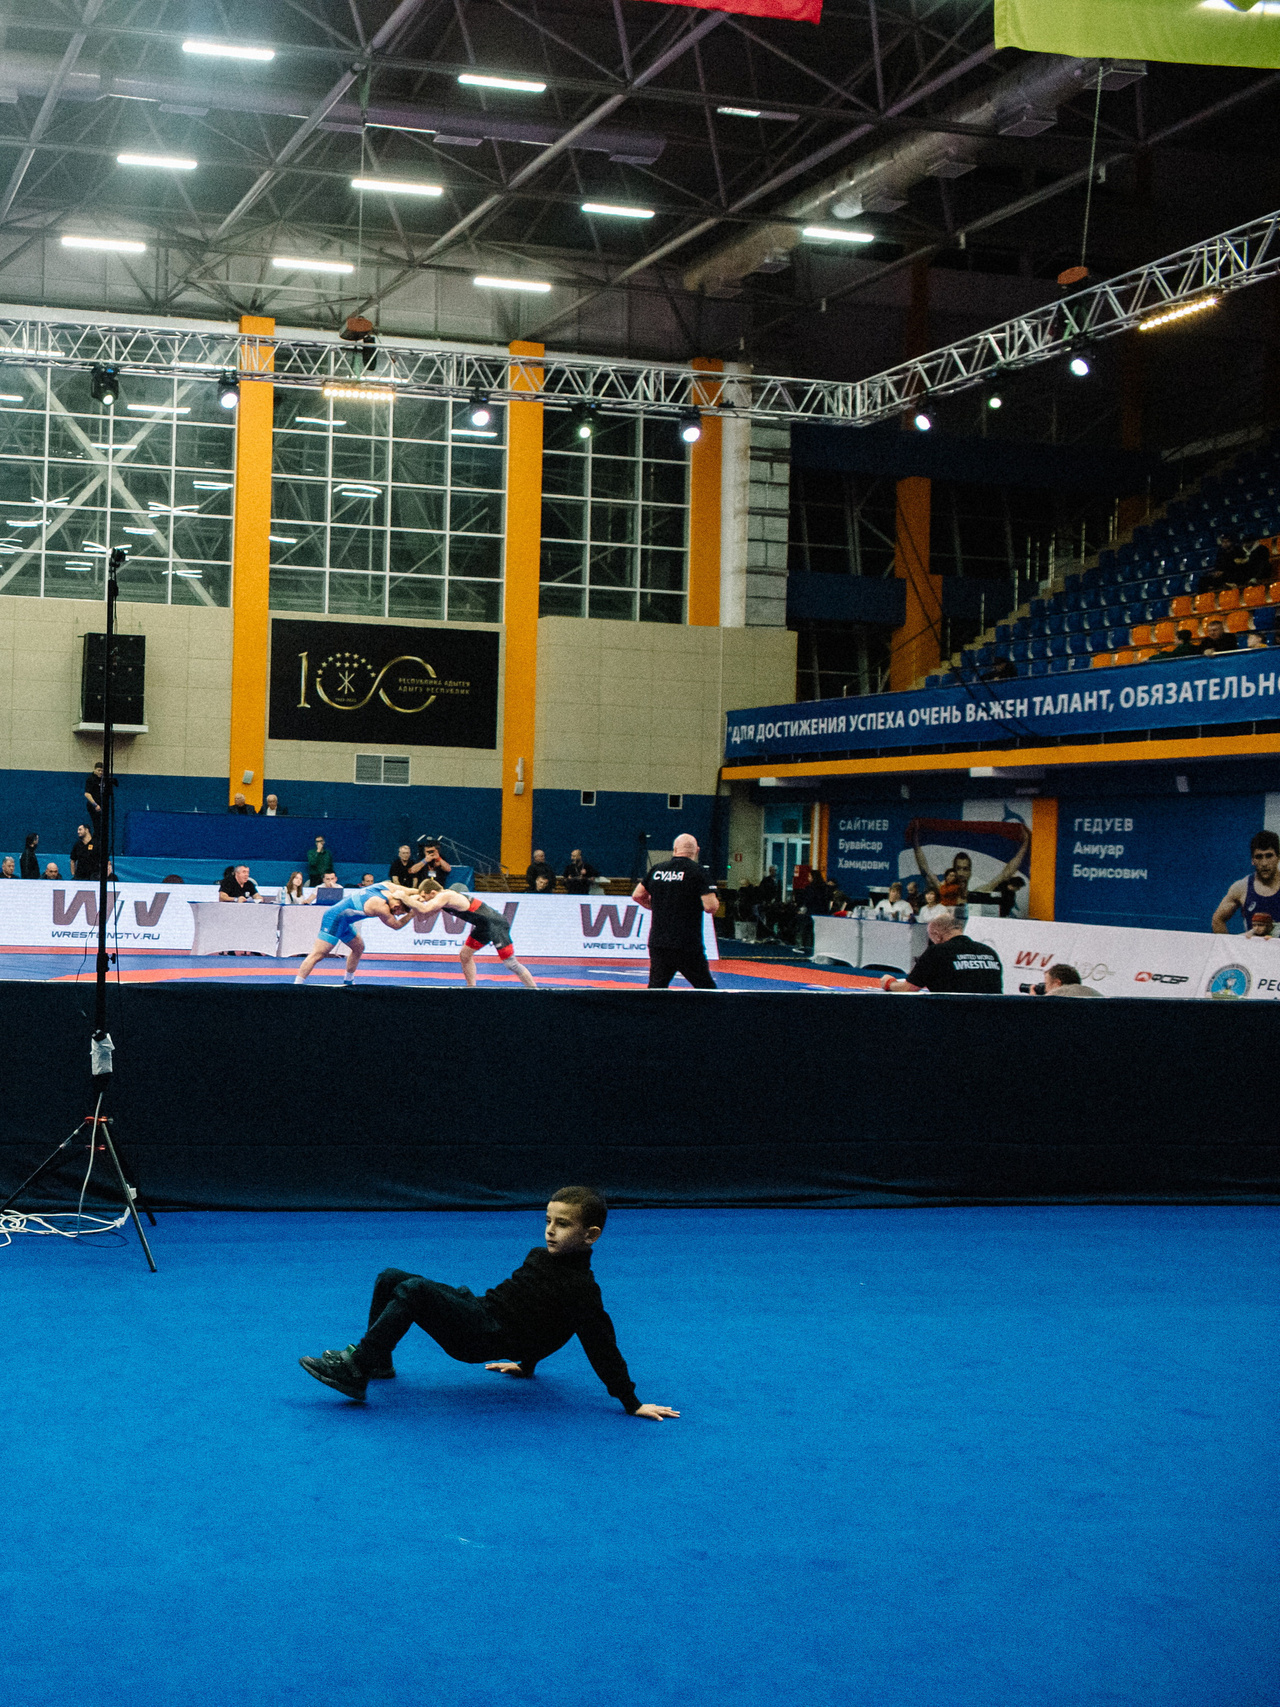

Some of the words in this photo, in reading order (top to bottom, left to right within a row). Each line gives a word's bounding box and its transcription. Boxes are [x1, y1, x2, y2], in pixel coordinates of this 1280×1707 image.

[756, 715, 847, 742] ДОСТИЖЕНИЯ
[849, 709, 905, 733] УСПЕХА
[908, 703, 962, 728] ОЧЕНЬ
[965, 697, 1029, 722] ВАЖЕН
[1032, 689, 1115, 716] ТАЛАНТ,
[1119, 672, 1280, 709] ОБЯЗАТЕЛЬН
[838, 817, 890, 832] САЙТИЕВ
[1073, 817, 1134, 834] ГЕДУЕВ
[838, 838, 883, 853] Бувайсар
[1073, 841, 1125, 858] Аниуар
[838, 857, 890, 871] Хамидович
[1072, 863, 1148, 880] Борисович
[652, 870, 685, 882] СУДЬЯ
[583, 942, 647, 950] WRESTLING
[952, 960, 1001, 971] WRESTLING
